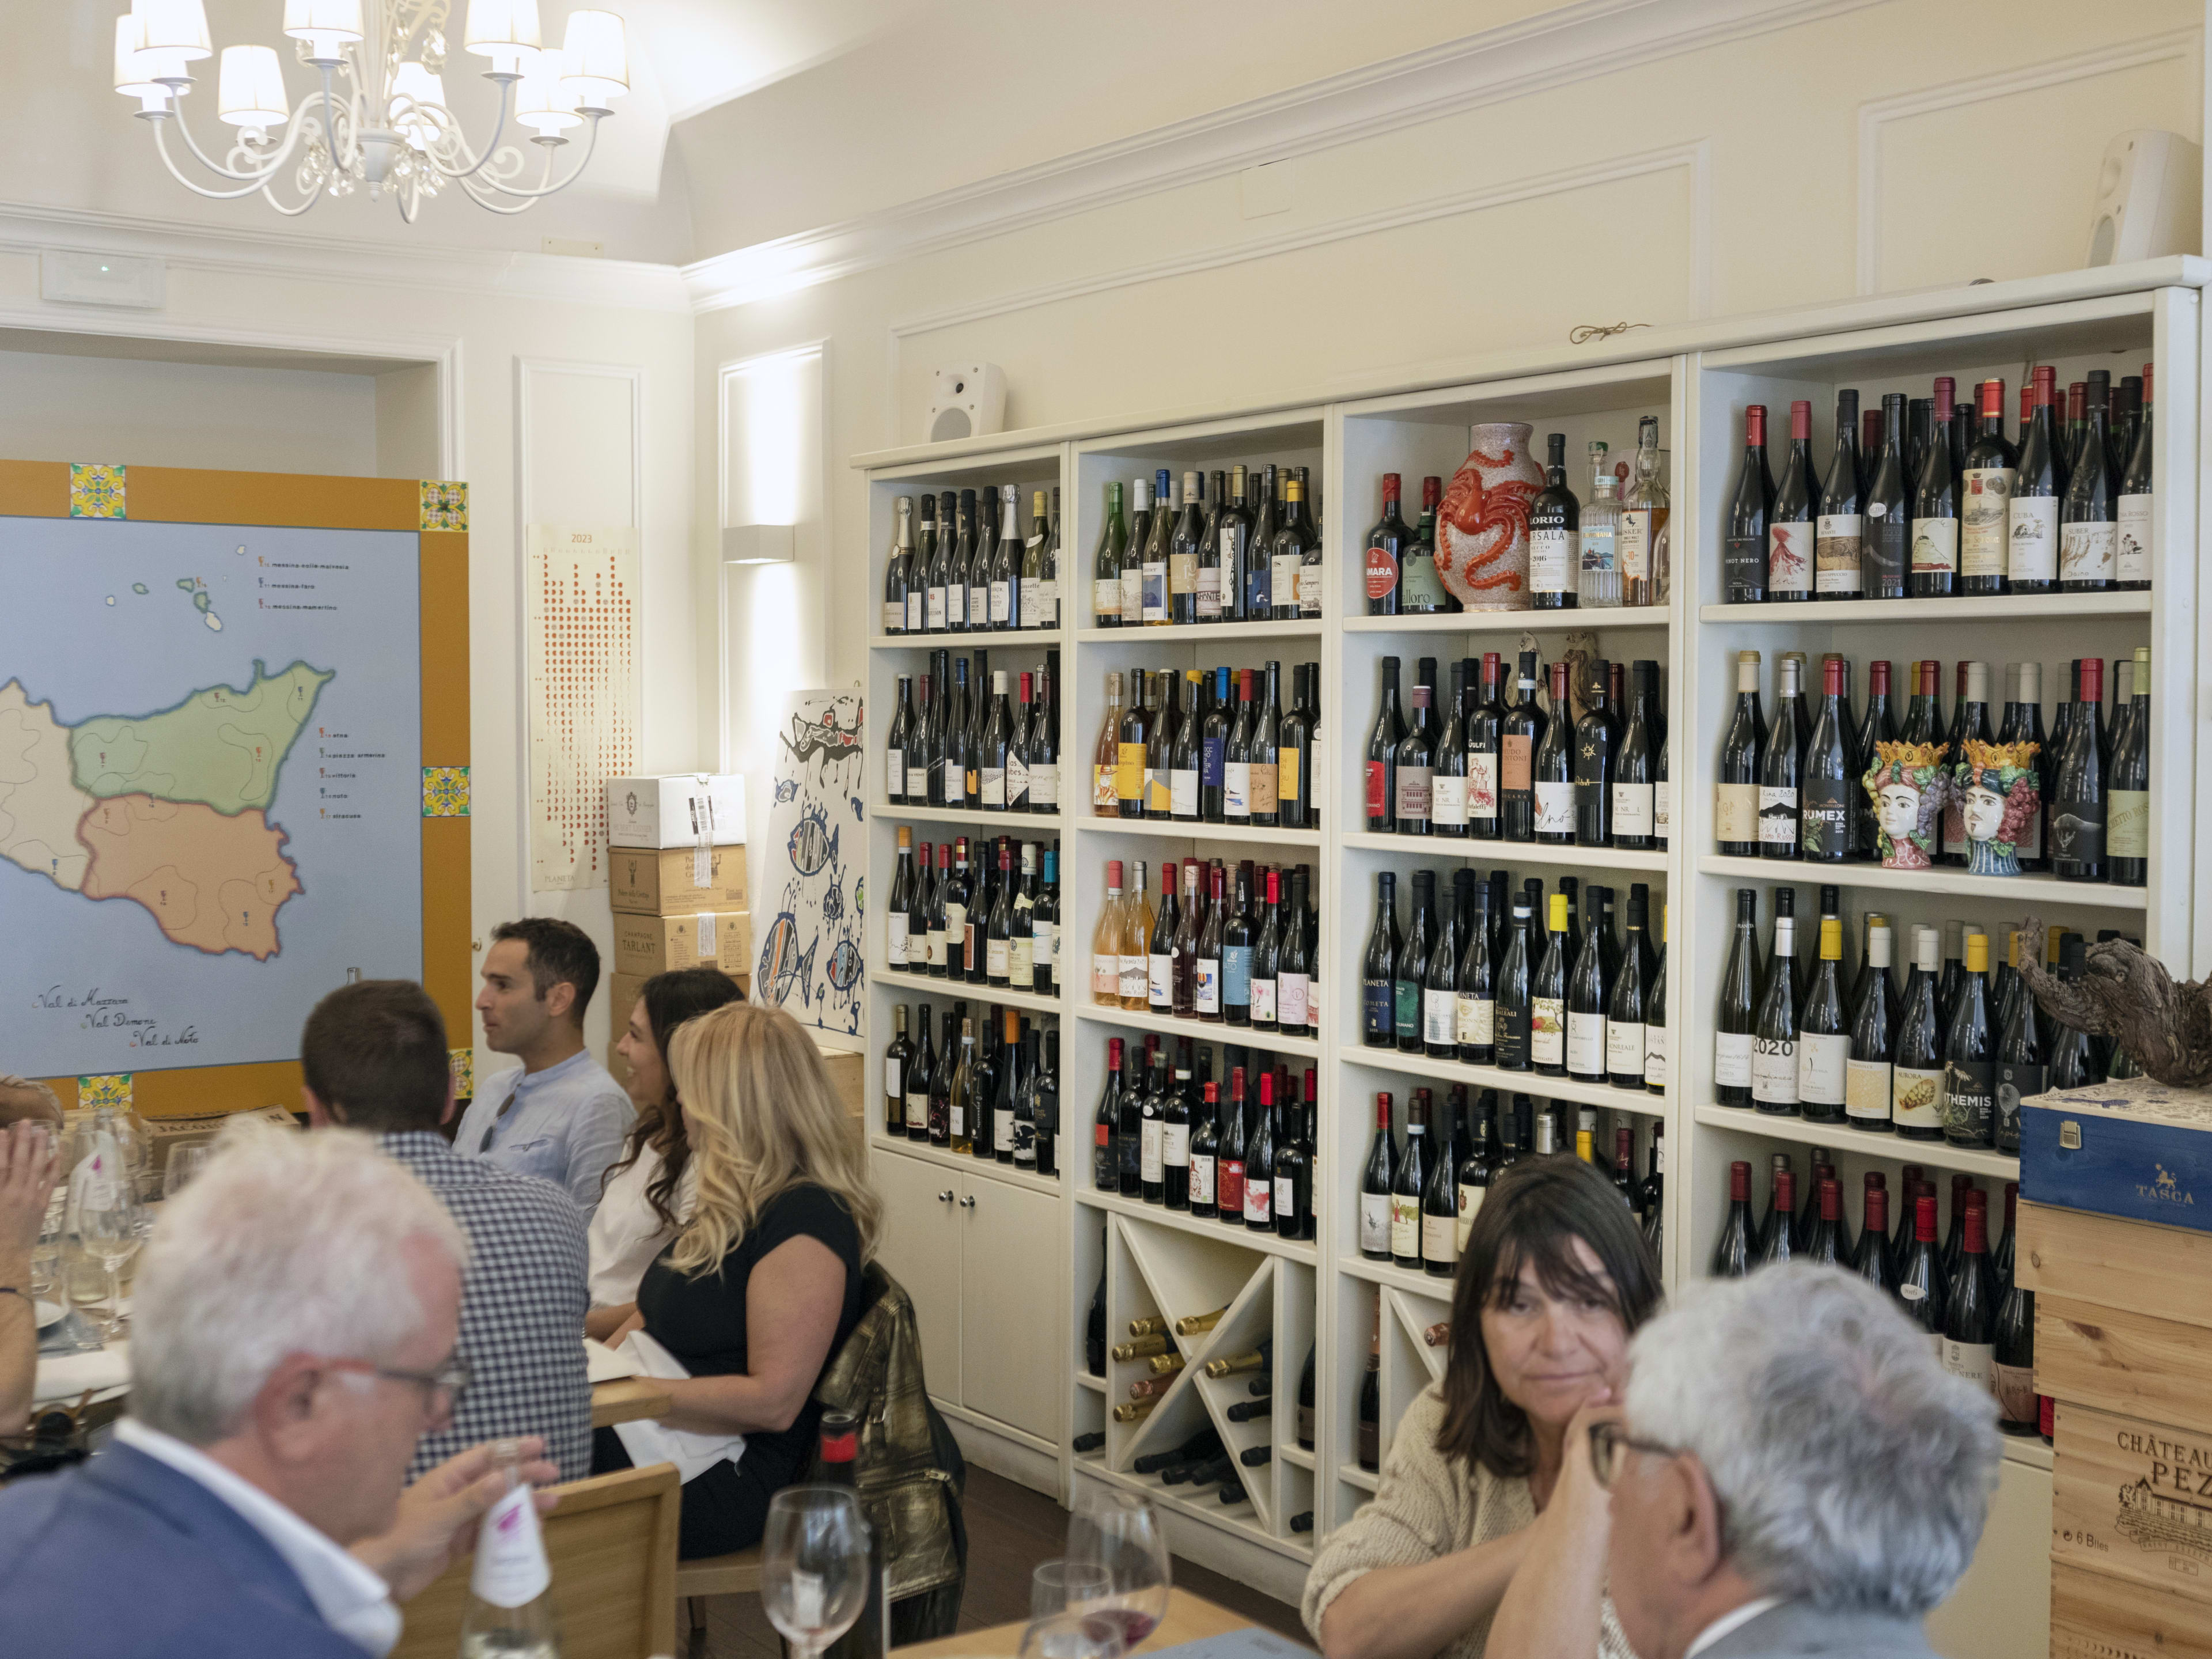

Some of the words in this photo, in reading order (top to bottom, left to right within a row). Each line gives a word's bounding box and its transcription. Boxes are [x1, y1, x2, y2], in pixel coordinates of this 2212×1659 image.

[571, 533, 592, 543] 2023
[1628, 551, 1634, 560] 10
[1468, 738, 1486, 748] GULFI
[1779, 788, 1794, 798] 2020
[1802, 810, 1846, 821] RUMEX
[624, 930, 653, 940] CHAMPAGNE
[622, 939, 655, 955] TARLANT
[1363, 979, 1389, 988] PLANETA
[39, 985, 62, 1008] Val
[67, 998, 77, 1007] di
[86, 1007, 109, 1028] Val
[132, 1026, 158, 1047] Val
[161, 1035, 171, 1046] di
[175, 1025, 199, 1045] Noto
[1754, 1037, 1794, 1056] 2020
[1898, 1071, 1922, 1080] AURORA
[2135, 1184, 2194, 1205] TASCA
[2118, 1432, 2212, 1469] CHÂTEAU
[2077, 1531, 2084, 1545] 6
